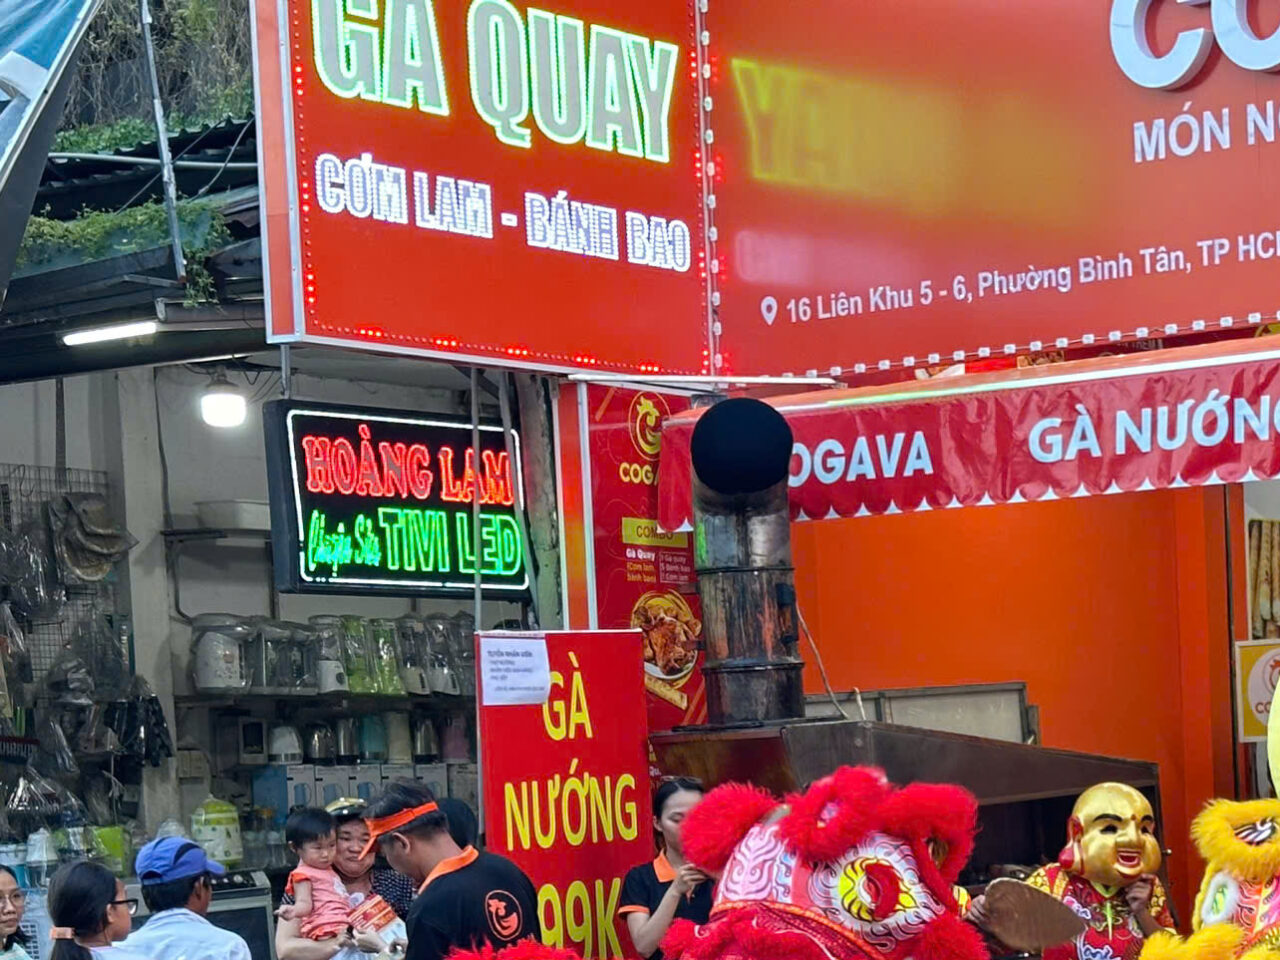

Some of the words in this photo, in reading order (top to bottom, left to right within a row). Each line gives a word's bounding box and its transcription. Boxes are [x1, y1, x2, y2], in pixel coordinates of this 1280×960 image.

[467, 0, 680, 163] QUAY
[1133, 97, 1231, 164] MÓN
[315, 151, 409, 226] CƠM
[413, 170, 494, 240] LAM
[524, 189, 619, 262] BÁNH
[625, 210, 692, 273] BAO
[786, 298, 812, 324] 16
[816, 289, 863, 321] Liên
[869, 284, 914, 313] Khu
[919, 280, 933, 305] 5
[953, 275, 974, 304] 6,
[978, 262, 1073, 298] Phường
[1078, 250, 1133, 283] Bình
[1140, 245, 1192, 277] Tân,
[1197, 237, 1231, 266] TP
[302, 424, 434, 500] HOÀNG
[438, 447, 515, 506] LAM
[619, 461, 658, 486] COG
[1027, 403, 1101, 464] GÀ
[455, 511, 522, 576] LED
[542, 652, 593, 741] GÀ
[504, 758, 638, 850] NƯỚNG
